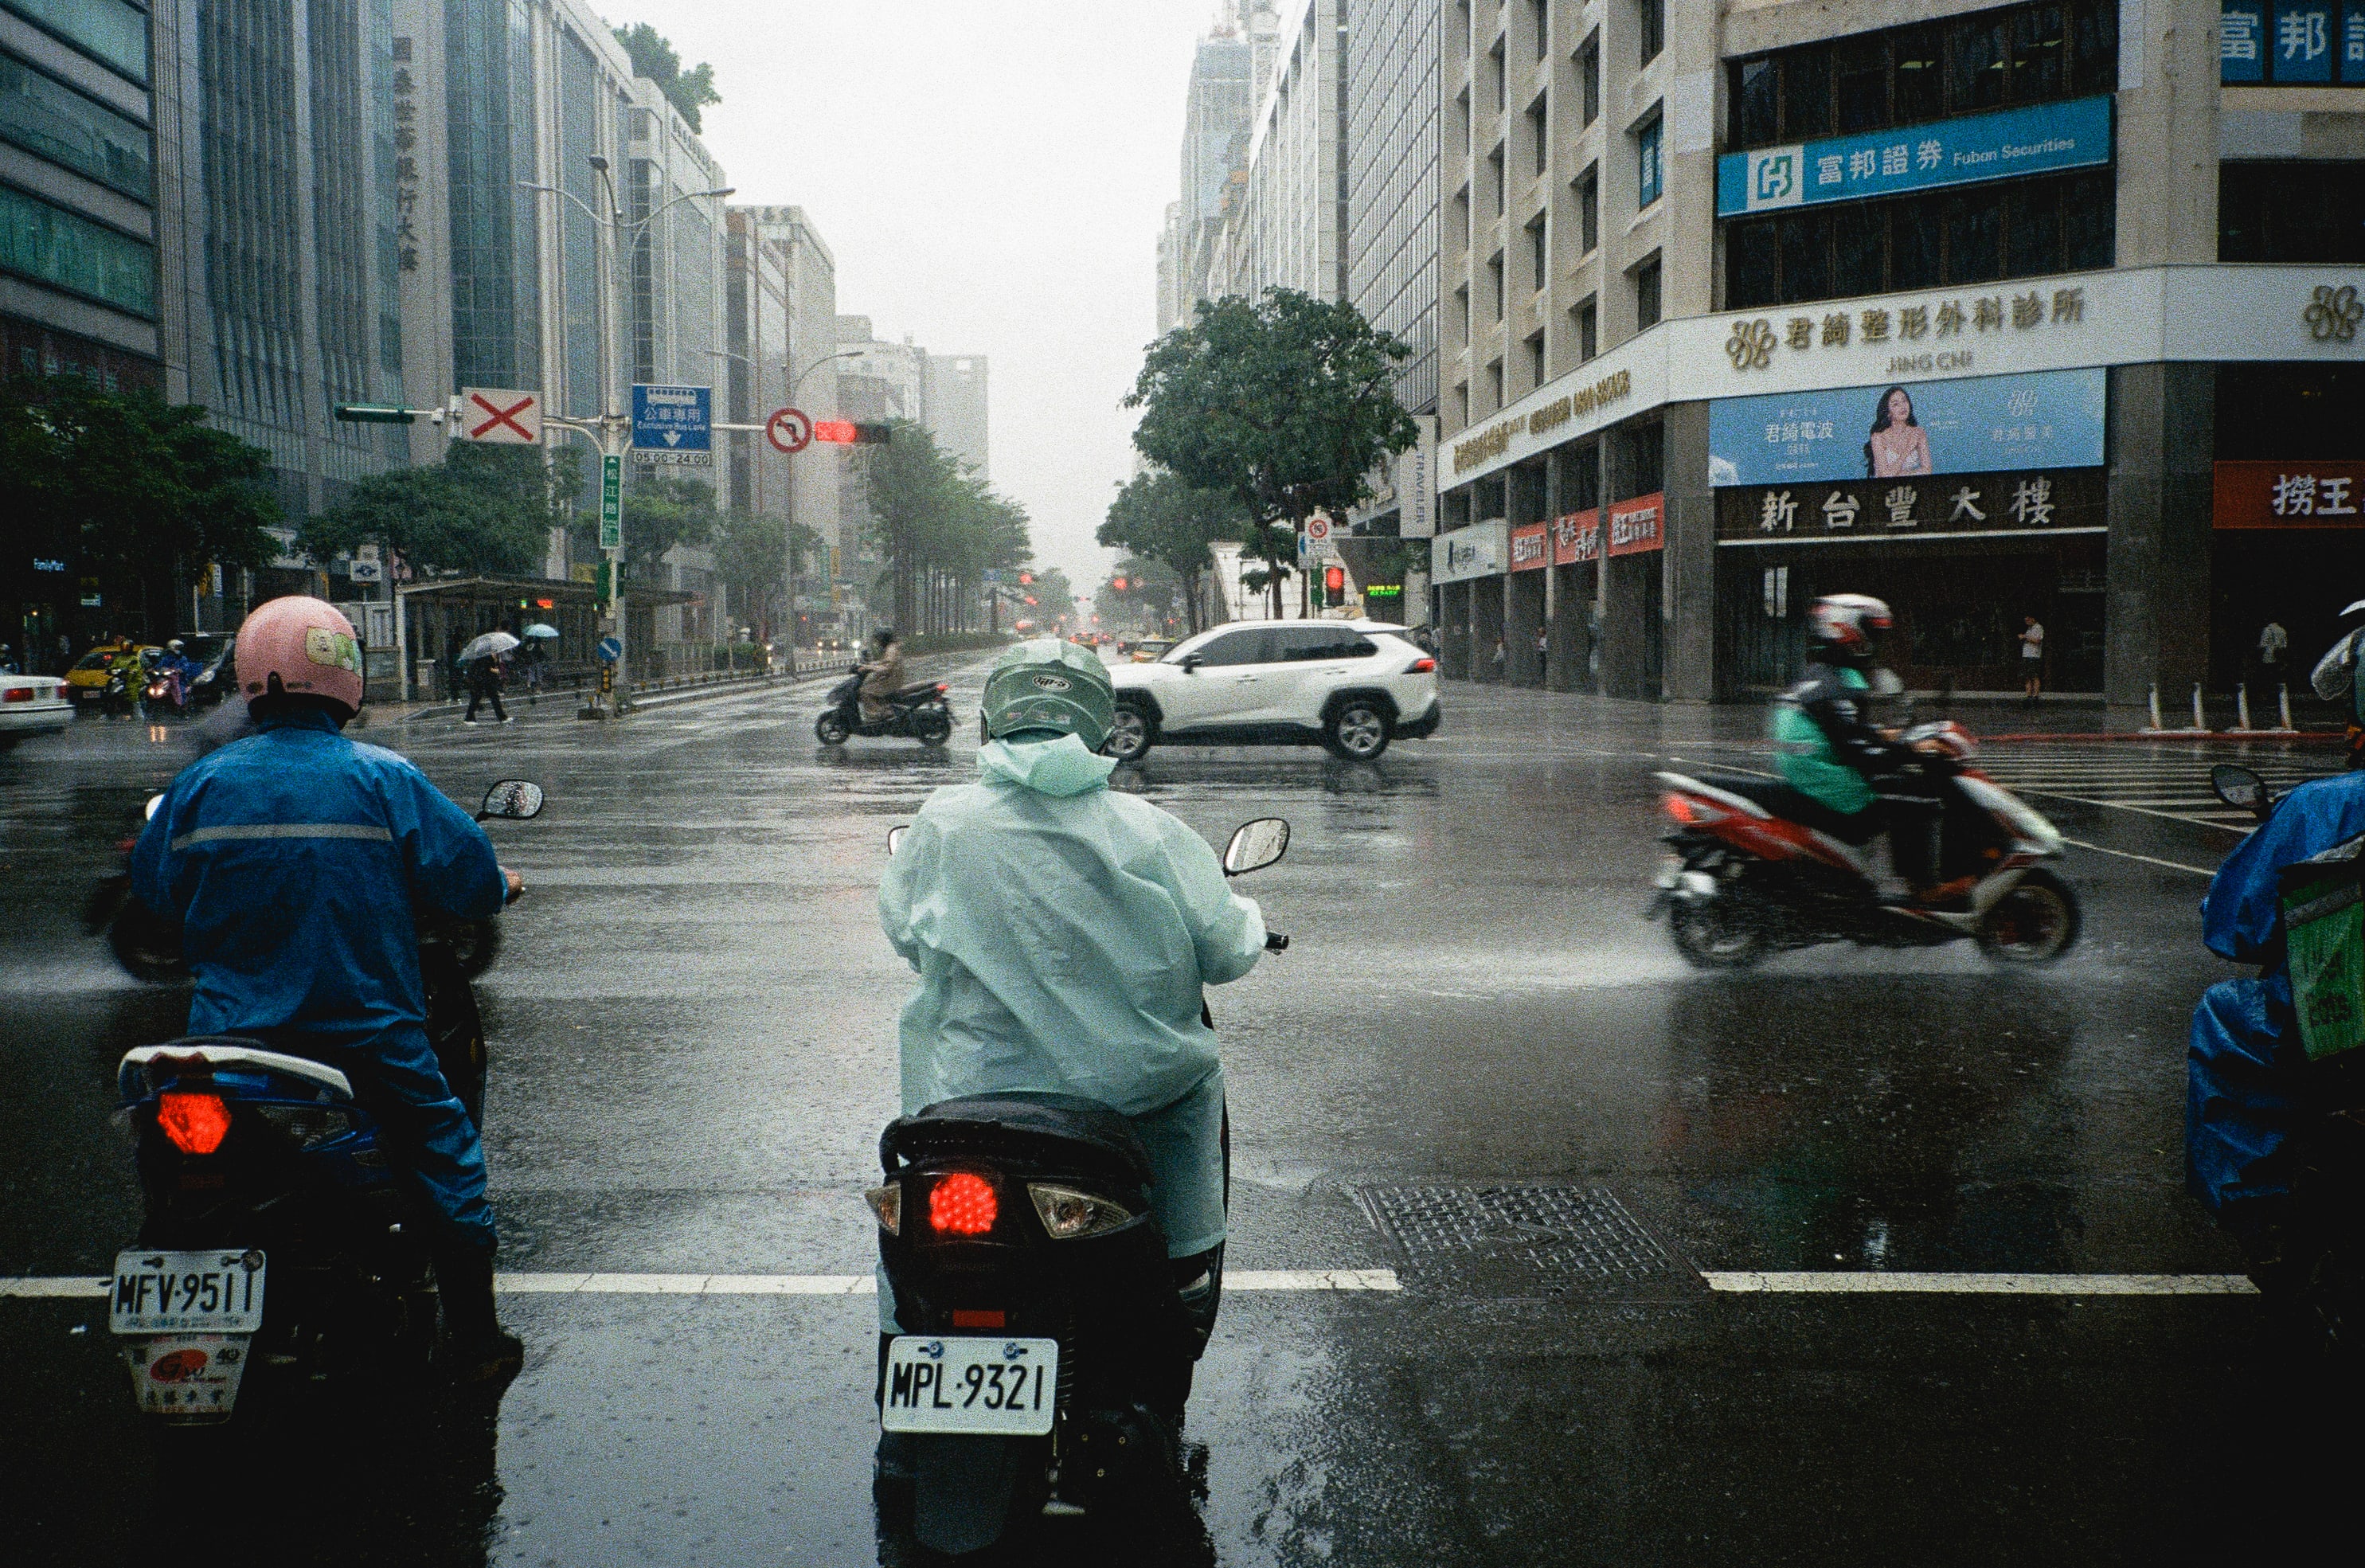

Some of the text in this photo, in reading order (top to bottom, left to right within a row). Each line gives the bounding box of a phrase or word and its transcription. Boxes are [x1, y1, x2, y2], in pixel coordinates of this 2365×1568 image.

[1817, 139, 1943, 185] 富邦證券
[1953, 138, 2076, 166] Fubon Securities
[1785, 288, 2085, 350] 君綺整形外科診所
[1885, 350, 1973, 373] JING CHI
[636, 420, 672, 429] Exclusive
[673, 421, 686, 430] Bus
[643, 406, 701, 421] 公車專用
[1765, 420, 1834, 443] 君綺電波
[604, 467, 617, 514] 松江路
[1416, 452, 1425, 522] TRAVELER
[1761, 476, 2056, 532] 新台豐大樓
[2272, 474, 2365, 515] 撈王
